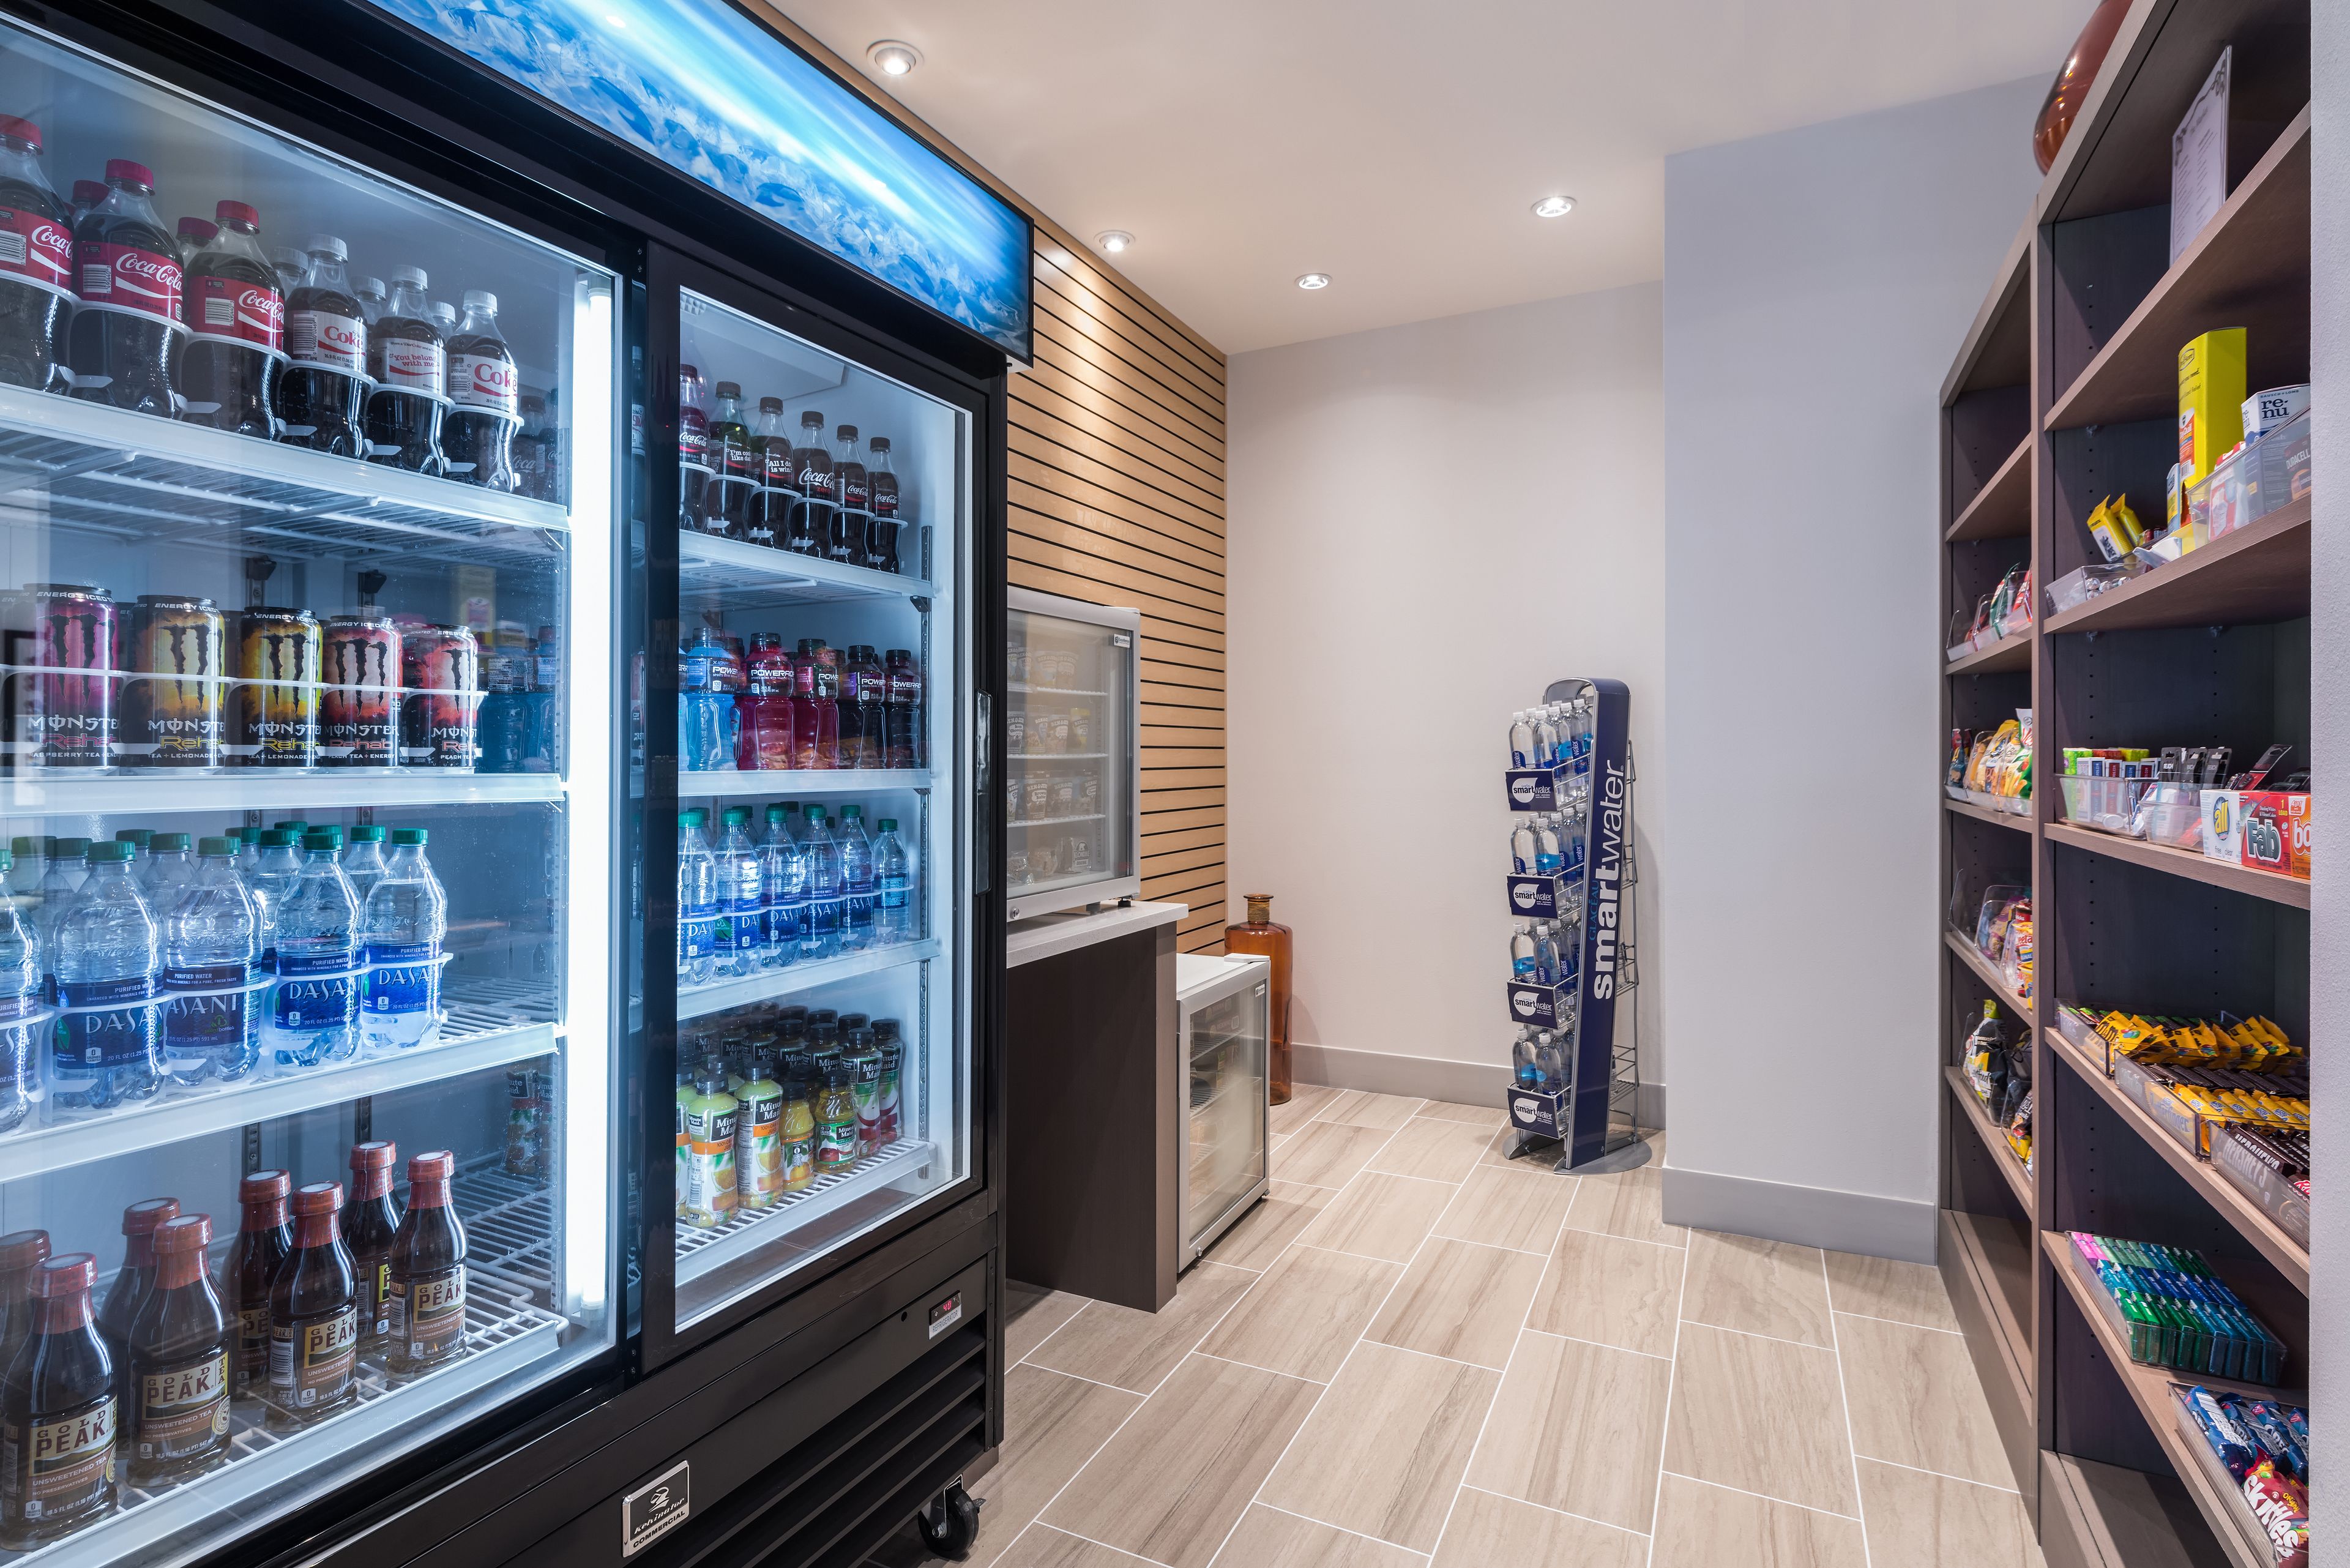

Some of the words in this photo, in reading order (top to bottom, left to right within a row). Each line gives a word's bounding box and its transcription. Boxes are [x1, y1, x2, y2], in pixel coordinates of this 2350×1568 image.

[324, 326, 363, 348] Coke
[474, 363, 518, 392] Coke
[2261, 406, 2290, 420] nu
[679, 431, 707, 447] Coca-Cola
[2286, 449, 2310, 470] DURACELL
[875, 493, 897, 504] Coca-Cola
[325, 723, 399, 736] MONSTER
[329, 738, 393, 750] Rehab
[1513, 785, 1552, 794] smartwater
[2281, 799, 2285, 809] 1
[2214, 800, 2229, 834] all
[2247, 817, 2281, 863] Fab
[2225, 846, 2233, 856] clear
[1594, 759, 1624, 999] smartwater
[1515, 892, 1553, 902] smartwater
[1588, 879, 1600, 941] GLACÉAU
[168, 994, 237, 1019] ASANI
[1515, 998, 1553, 1011] smartwater
[1515, 1105, 1553, 1121] smartwater
[419, 1285, 461, 1309] PEAK
[943, 1299, 952, 1311] 40
[311, 1313, 355, 1335] GOLD
[417, 1316, 456, 1331] UNSWEETENED
[422, 1325, 453, 1338] PRESERVATIVES
[932, 1310, 958, 1333] REFRIGERATOR
[310, 1320, 355, 1352] PEAK
[148, 1365, 211, 1387] GOLD
[308, 1357, 349, 1376] UNSWEETENED
[316, 1367, 347, 1383] PRESERVATIVES
[146, 1375, 211, 1404] PEAK
[37, 1409, 105, 1438] GOLD
[144, 1416, 198, 1430] UNSWEETENED
[199, 1409, 213, 1419] TEA
[35, 1421, 105, 1458] PEAK
[153, 1427, 192, 1438] PRESERVATIVES
[32, 1462, 94, 1486] UNSWEETENED
[95, 1455, 107, 1469] TEA
[42, 1476, 88, 1494] PRESERVATIVES
[47, 1507, 58, 1516] 18.5
[634, 1498, 685, 1535] Kelvinator
[633, 1510, 685, 1548] COMMERCIAL
